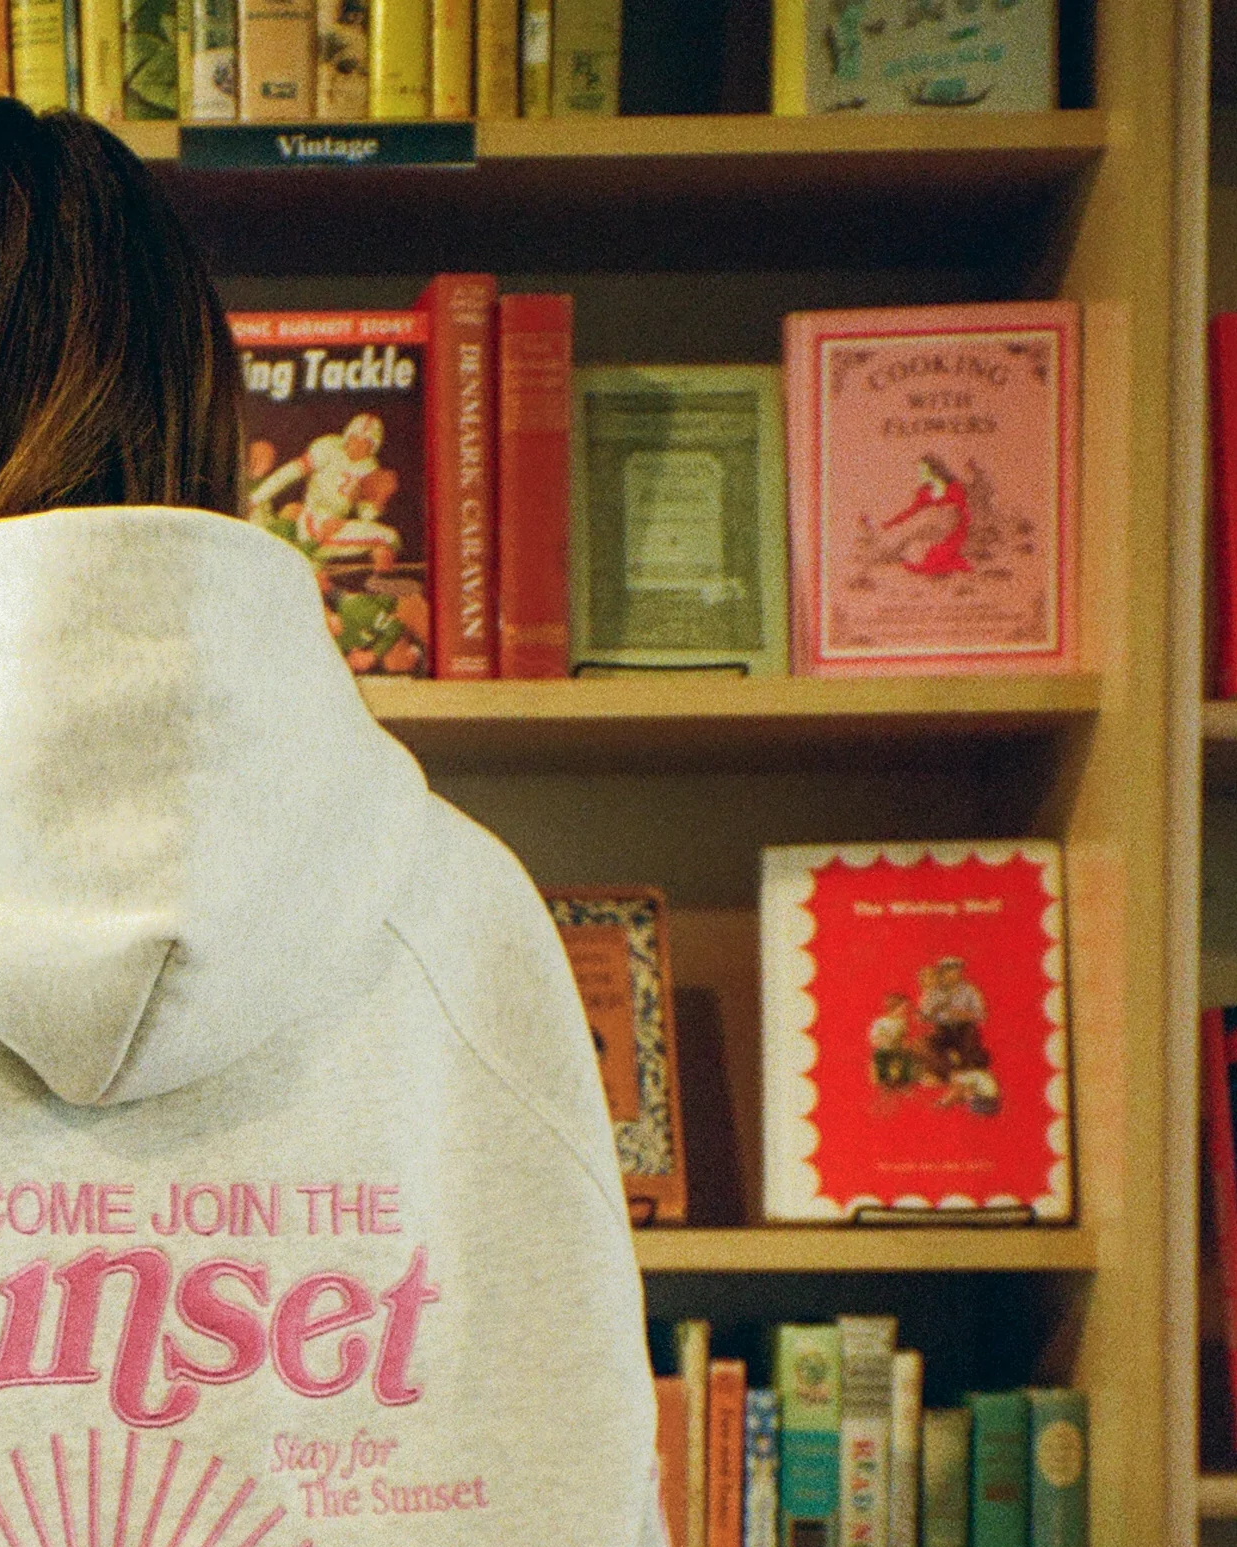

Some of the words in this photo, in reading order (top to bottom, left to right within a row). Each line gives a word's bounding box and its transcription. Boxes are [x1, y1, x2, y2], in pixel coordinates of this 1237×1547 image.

[275, 134, 379, 162] Vintage
[242, 349, 295, 400] ing
[303, 344, 417, 391] Tackle
[867, 354, 1009, 391] COOKING
[459, 343, 484, 487] DENMARK
[459, 499, 484, 640] CARAVAN
[150, 1183, 279, 1238] JOIN
[297, 1183, 401, 1236] THE
[270, 1431, 340, 1478] Stay
[339, 1426, 399, 1480] for
[298, 1477, 363, 1519] The
[370, 1474, 491, 1516] Sunset
